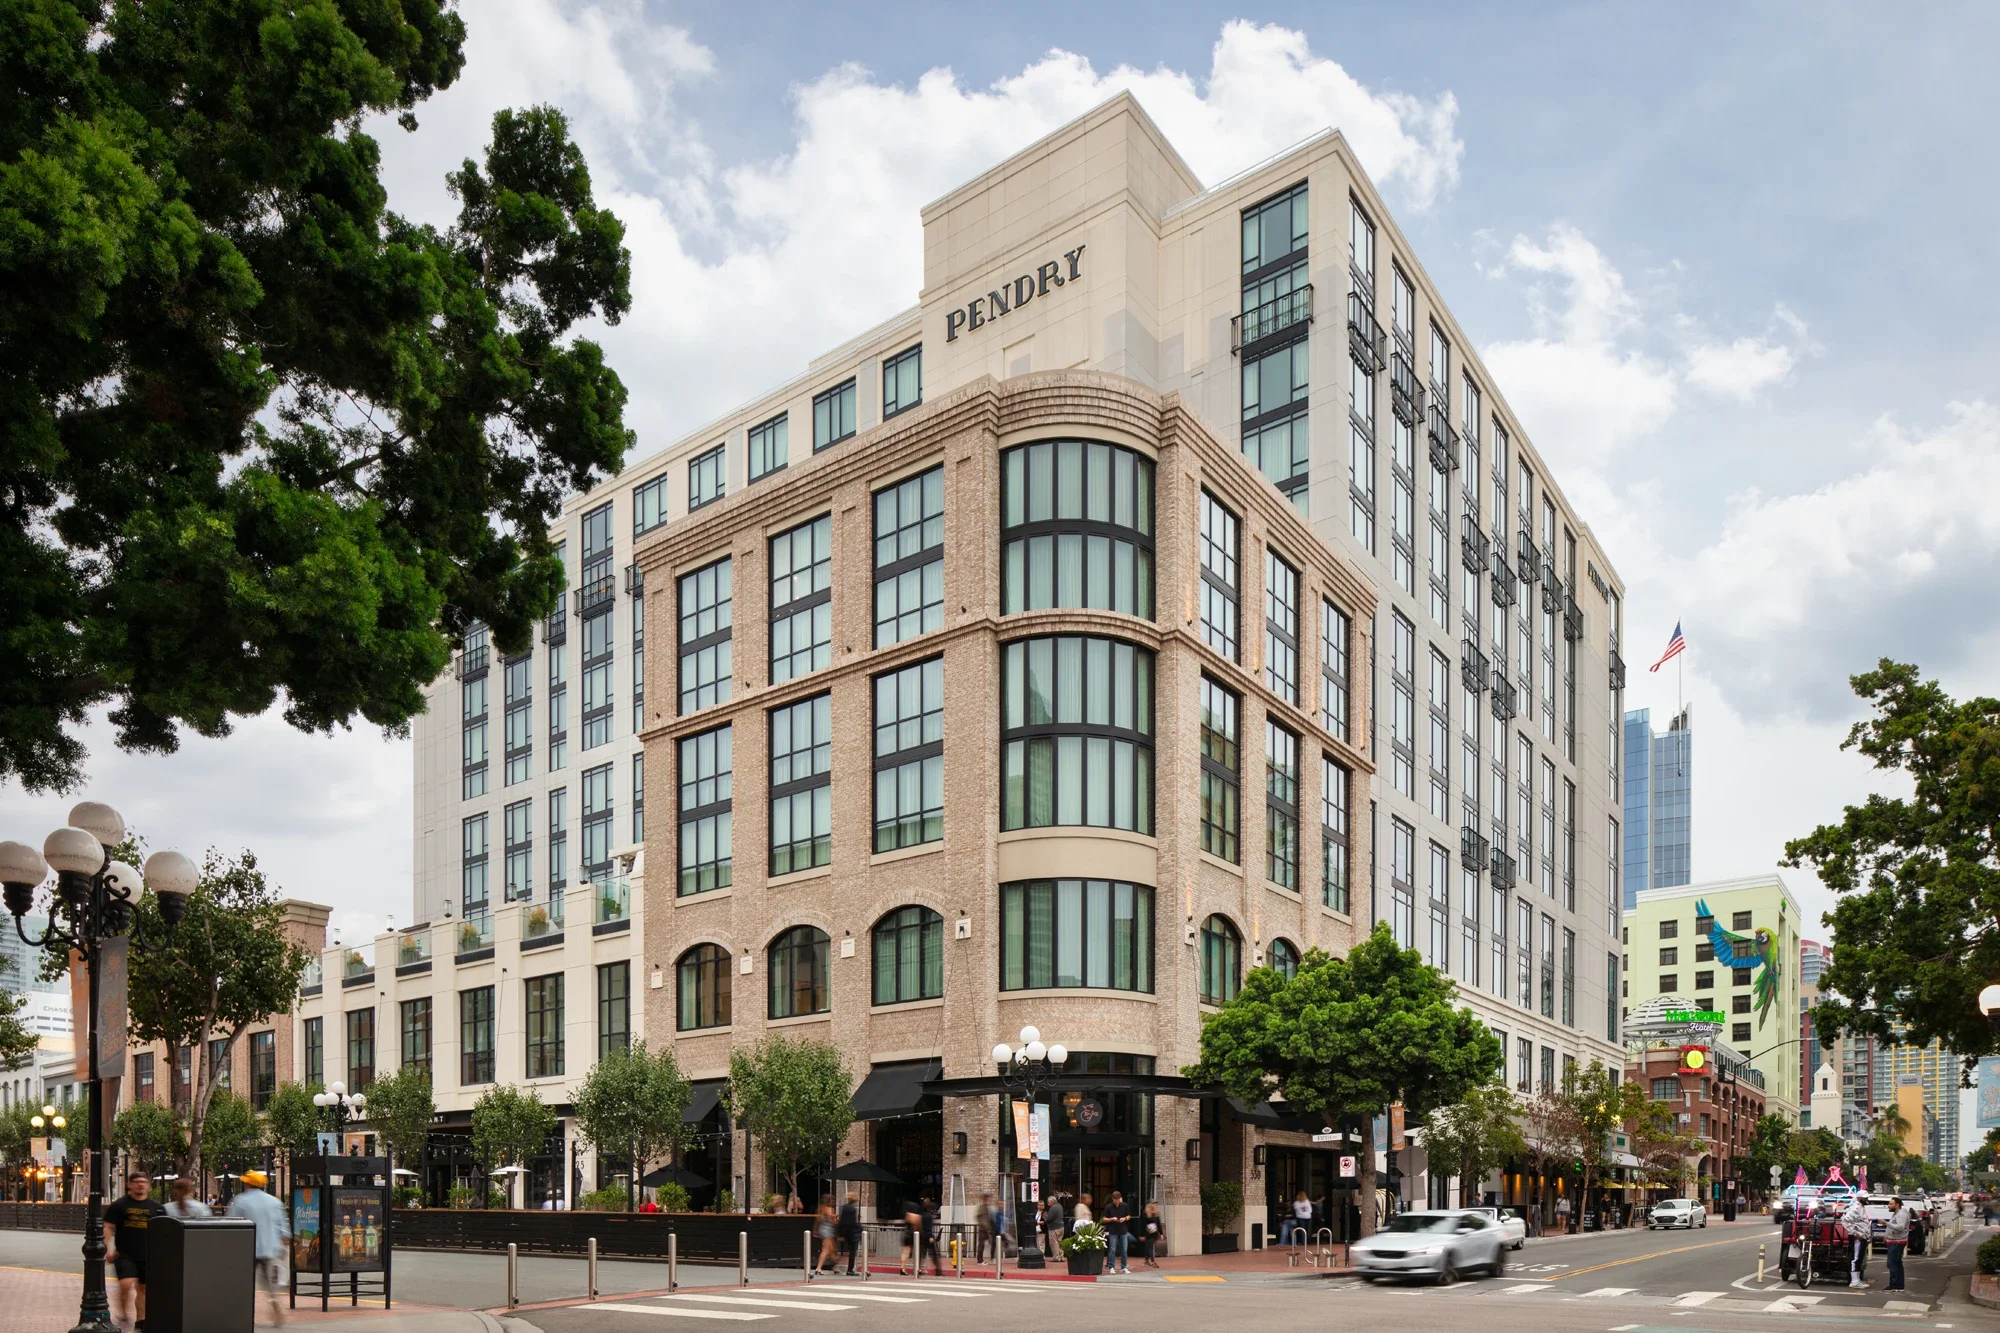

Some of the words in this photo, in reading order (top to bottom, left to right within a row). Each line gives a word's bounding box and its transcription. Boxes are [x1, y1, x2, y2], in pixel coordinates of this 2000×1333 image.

[945, 244, 1086, 343] PENDRY
[43, 1005, 68, 1014] CHASE
[1689, 1022, 1714, 1032] Hotel
[1503, 1263, 1570, 1272] US
